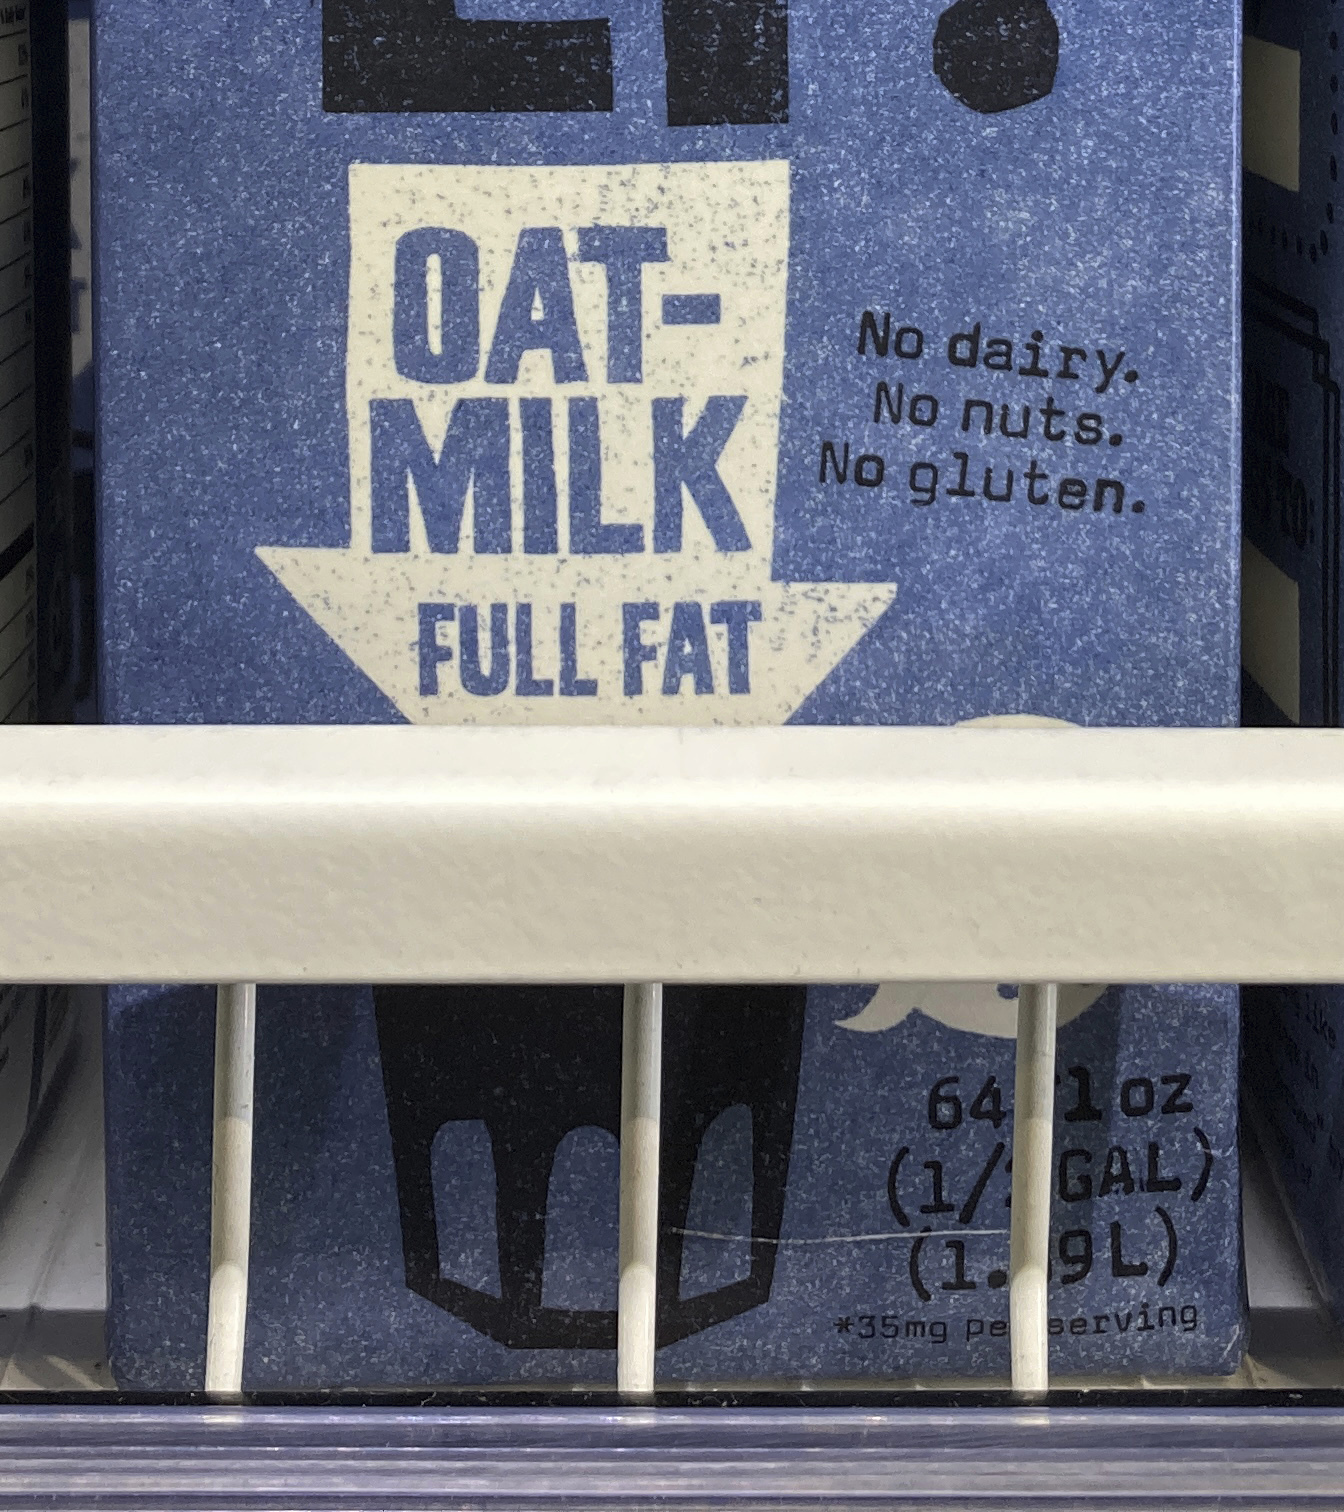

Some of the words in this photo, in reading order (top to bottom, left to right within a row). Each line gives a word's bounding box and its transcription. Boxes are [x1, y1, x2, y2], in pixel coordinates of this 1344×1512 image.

[391, 225, 721, 386] OAT-
[857, 309, 924, 361] No
[948, 322, 1141, 397] dairy.
[873, 382, 940, 428] No
[961, 395, 1125, 447] nuts.
[368, 394, 752, 556] MILK
[819, 440, 885, 489] No
[910, 451, 1147, 515] gluten.
[417, 600, 598, 698] FULL
[622, 600, 763, 696] FAT
[928, 1075, 1007, 1130] 64
[1119, 1073, 1194, 1117] oz
[887, 1141, 1012, 1228] (1/
[1058, 1126, 1215, 1203] GAL)
[909, 1225, 1093, 1302] (1.9
[1110, 1205, 1179, 1288] L)
[966, 1317, 1011, 1342] pe
[1047, 1302, 1199, 1337] serving
